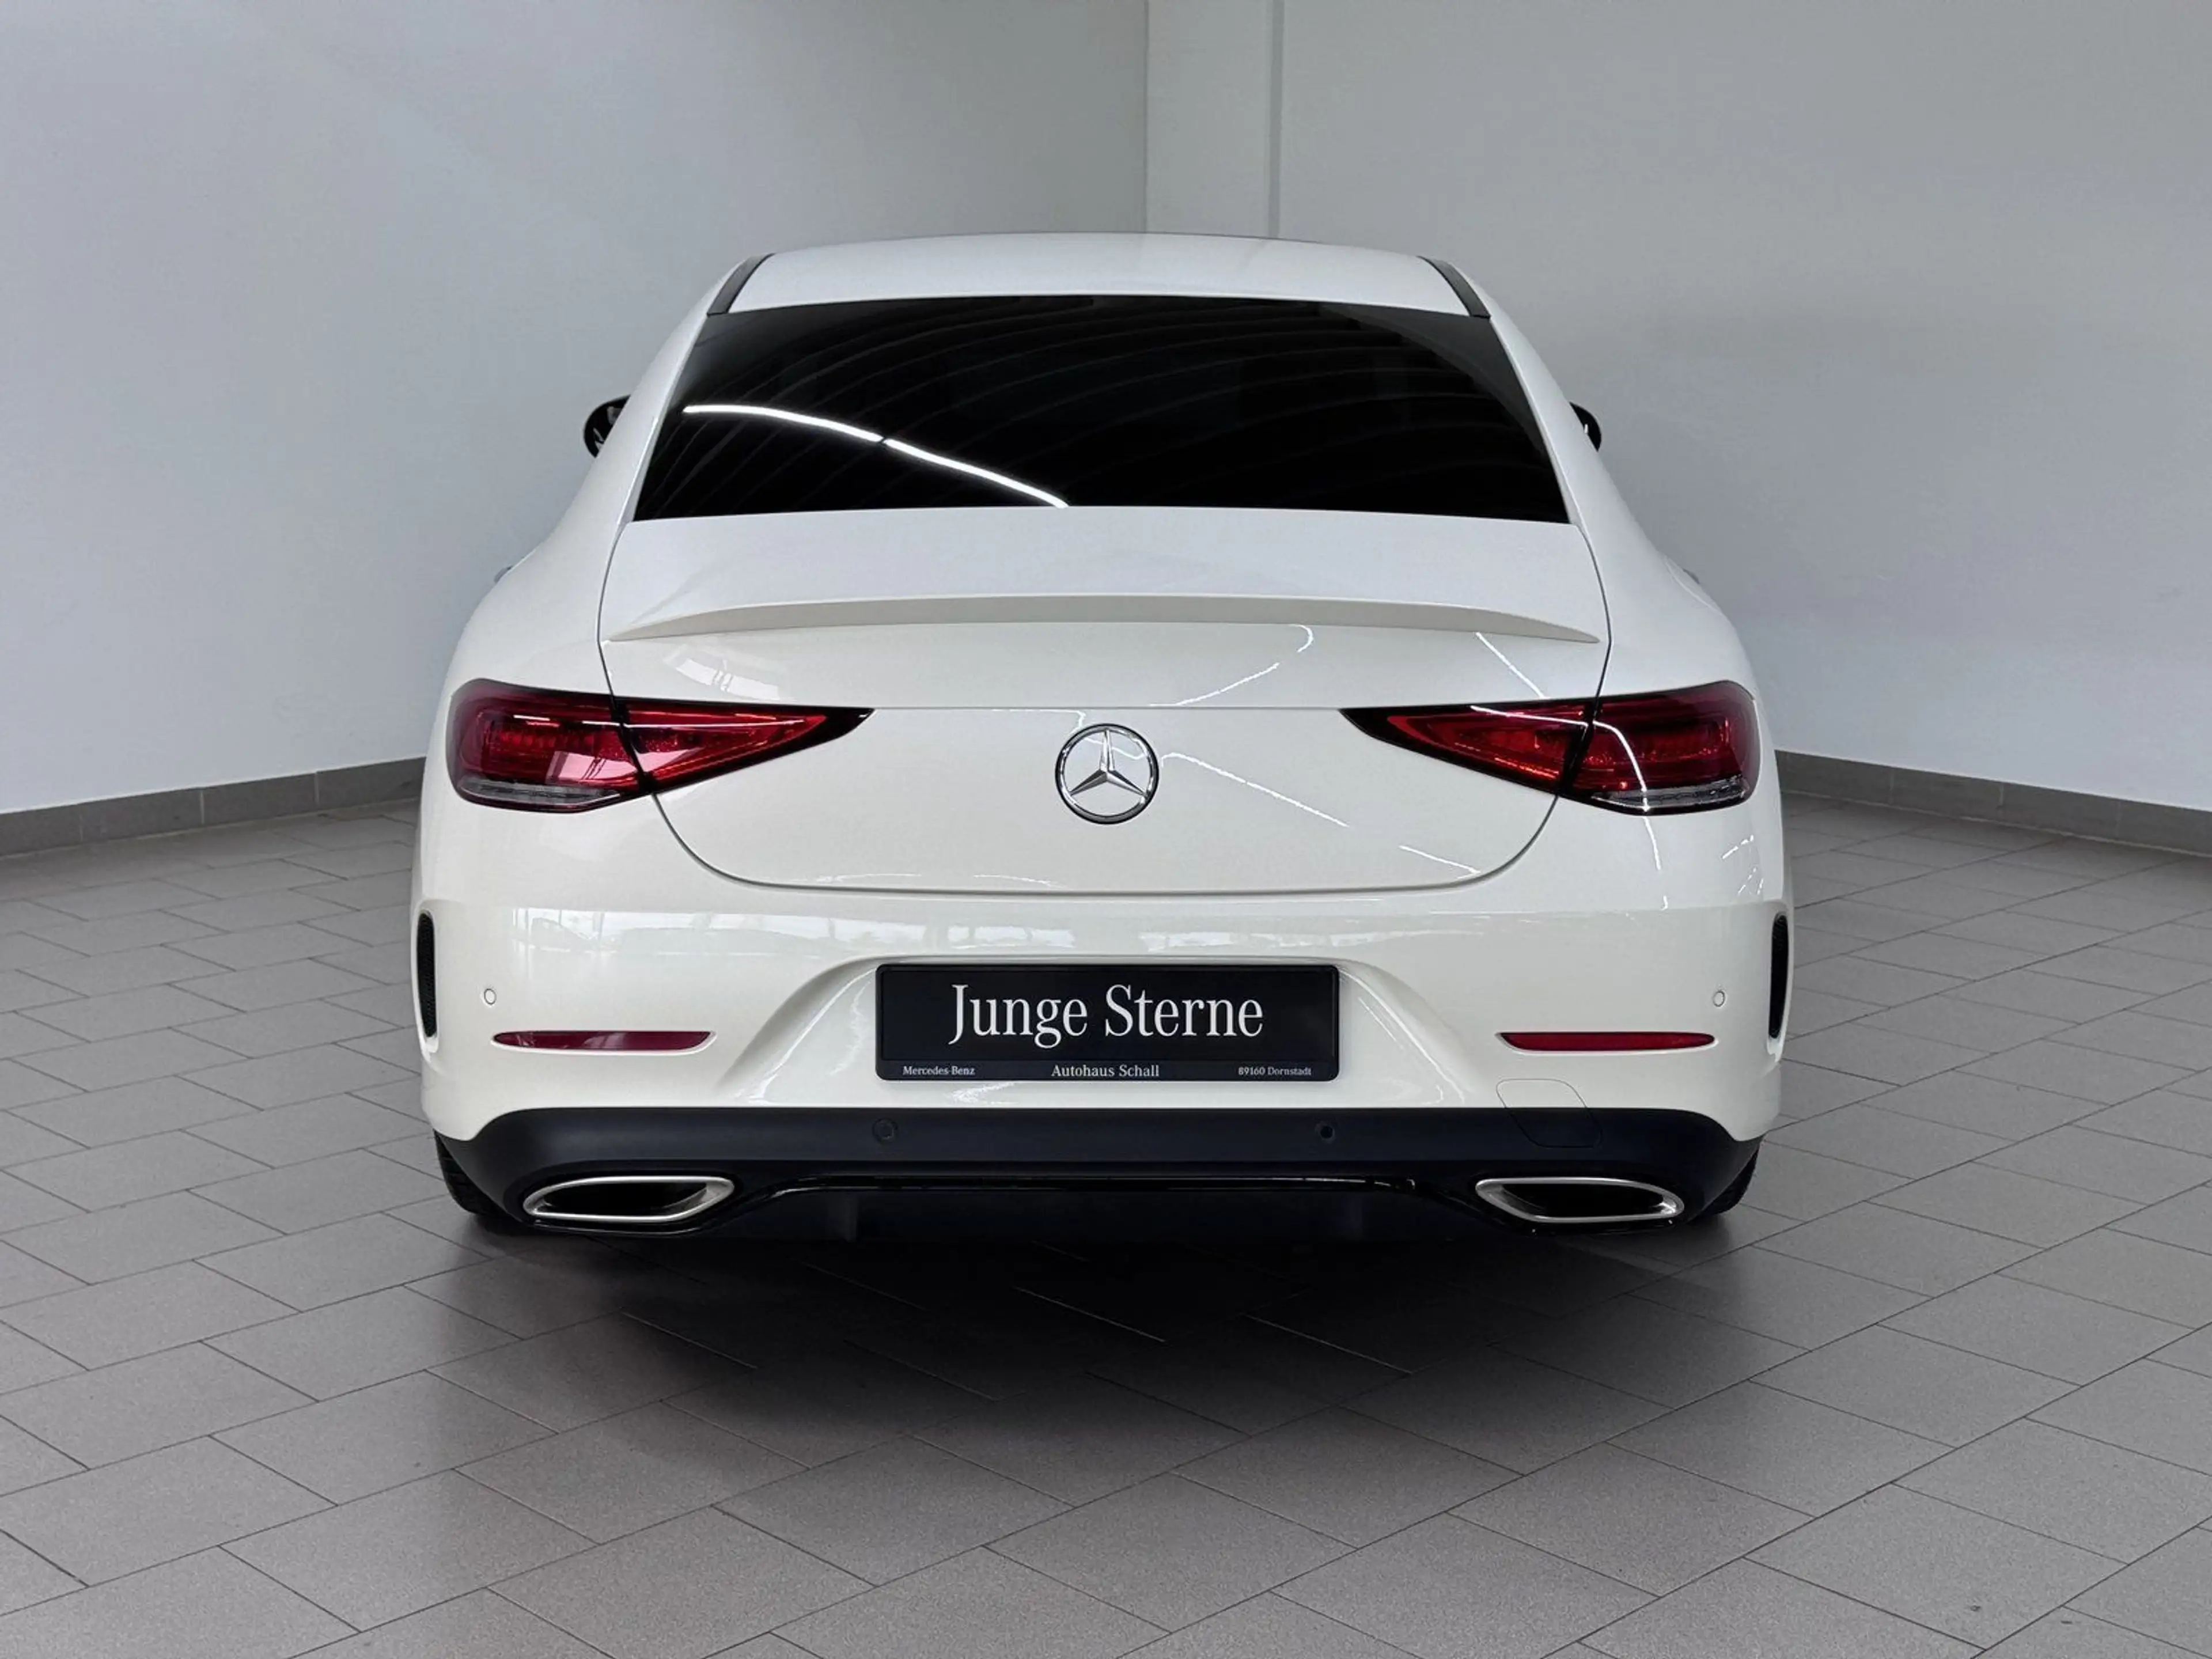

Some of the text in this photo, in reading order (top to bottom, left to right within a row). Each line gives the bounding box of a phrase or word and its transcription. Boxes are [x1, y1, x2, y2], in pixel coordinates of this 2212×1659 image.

[948, 984, 1263, 1050] Junge Sterne
[1051, 1065, 1160, 1077] Autohaus Schall
[1238, 1066, 1312, 1075] 89160 Dornstadt
